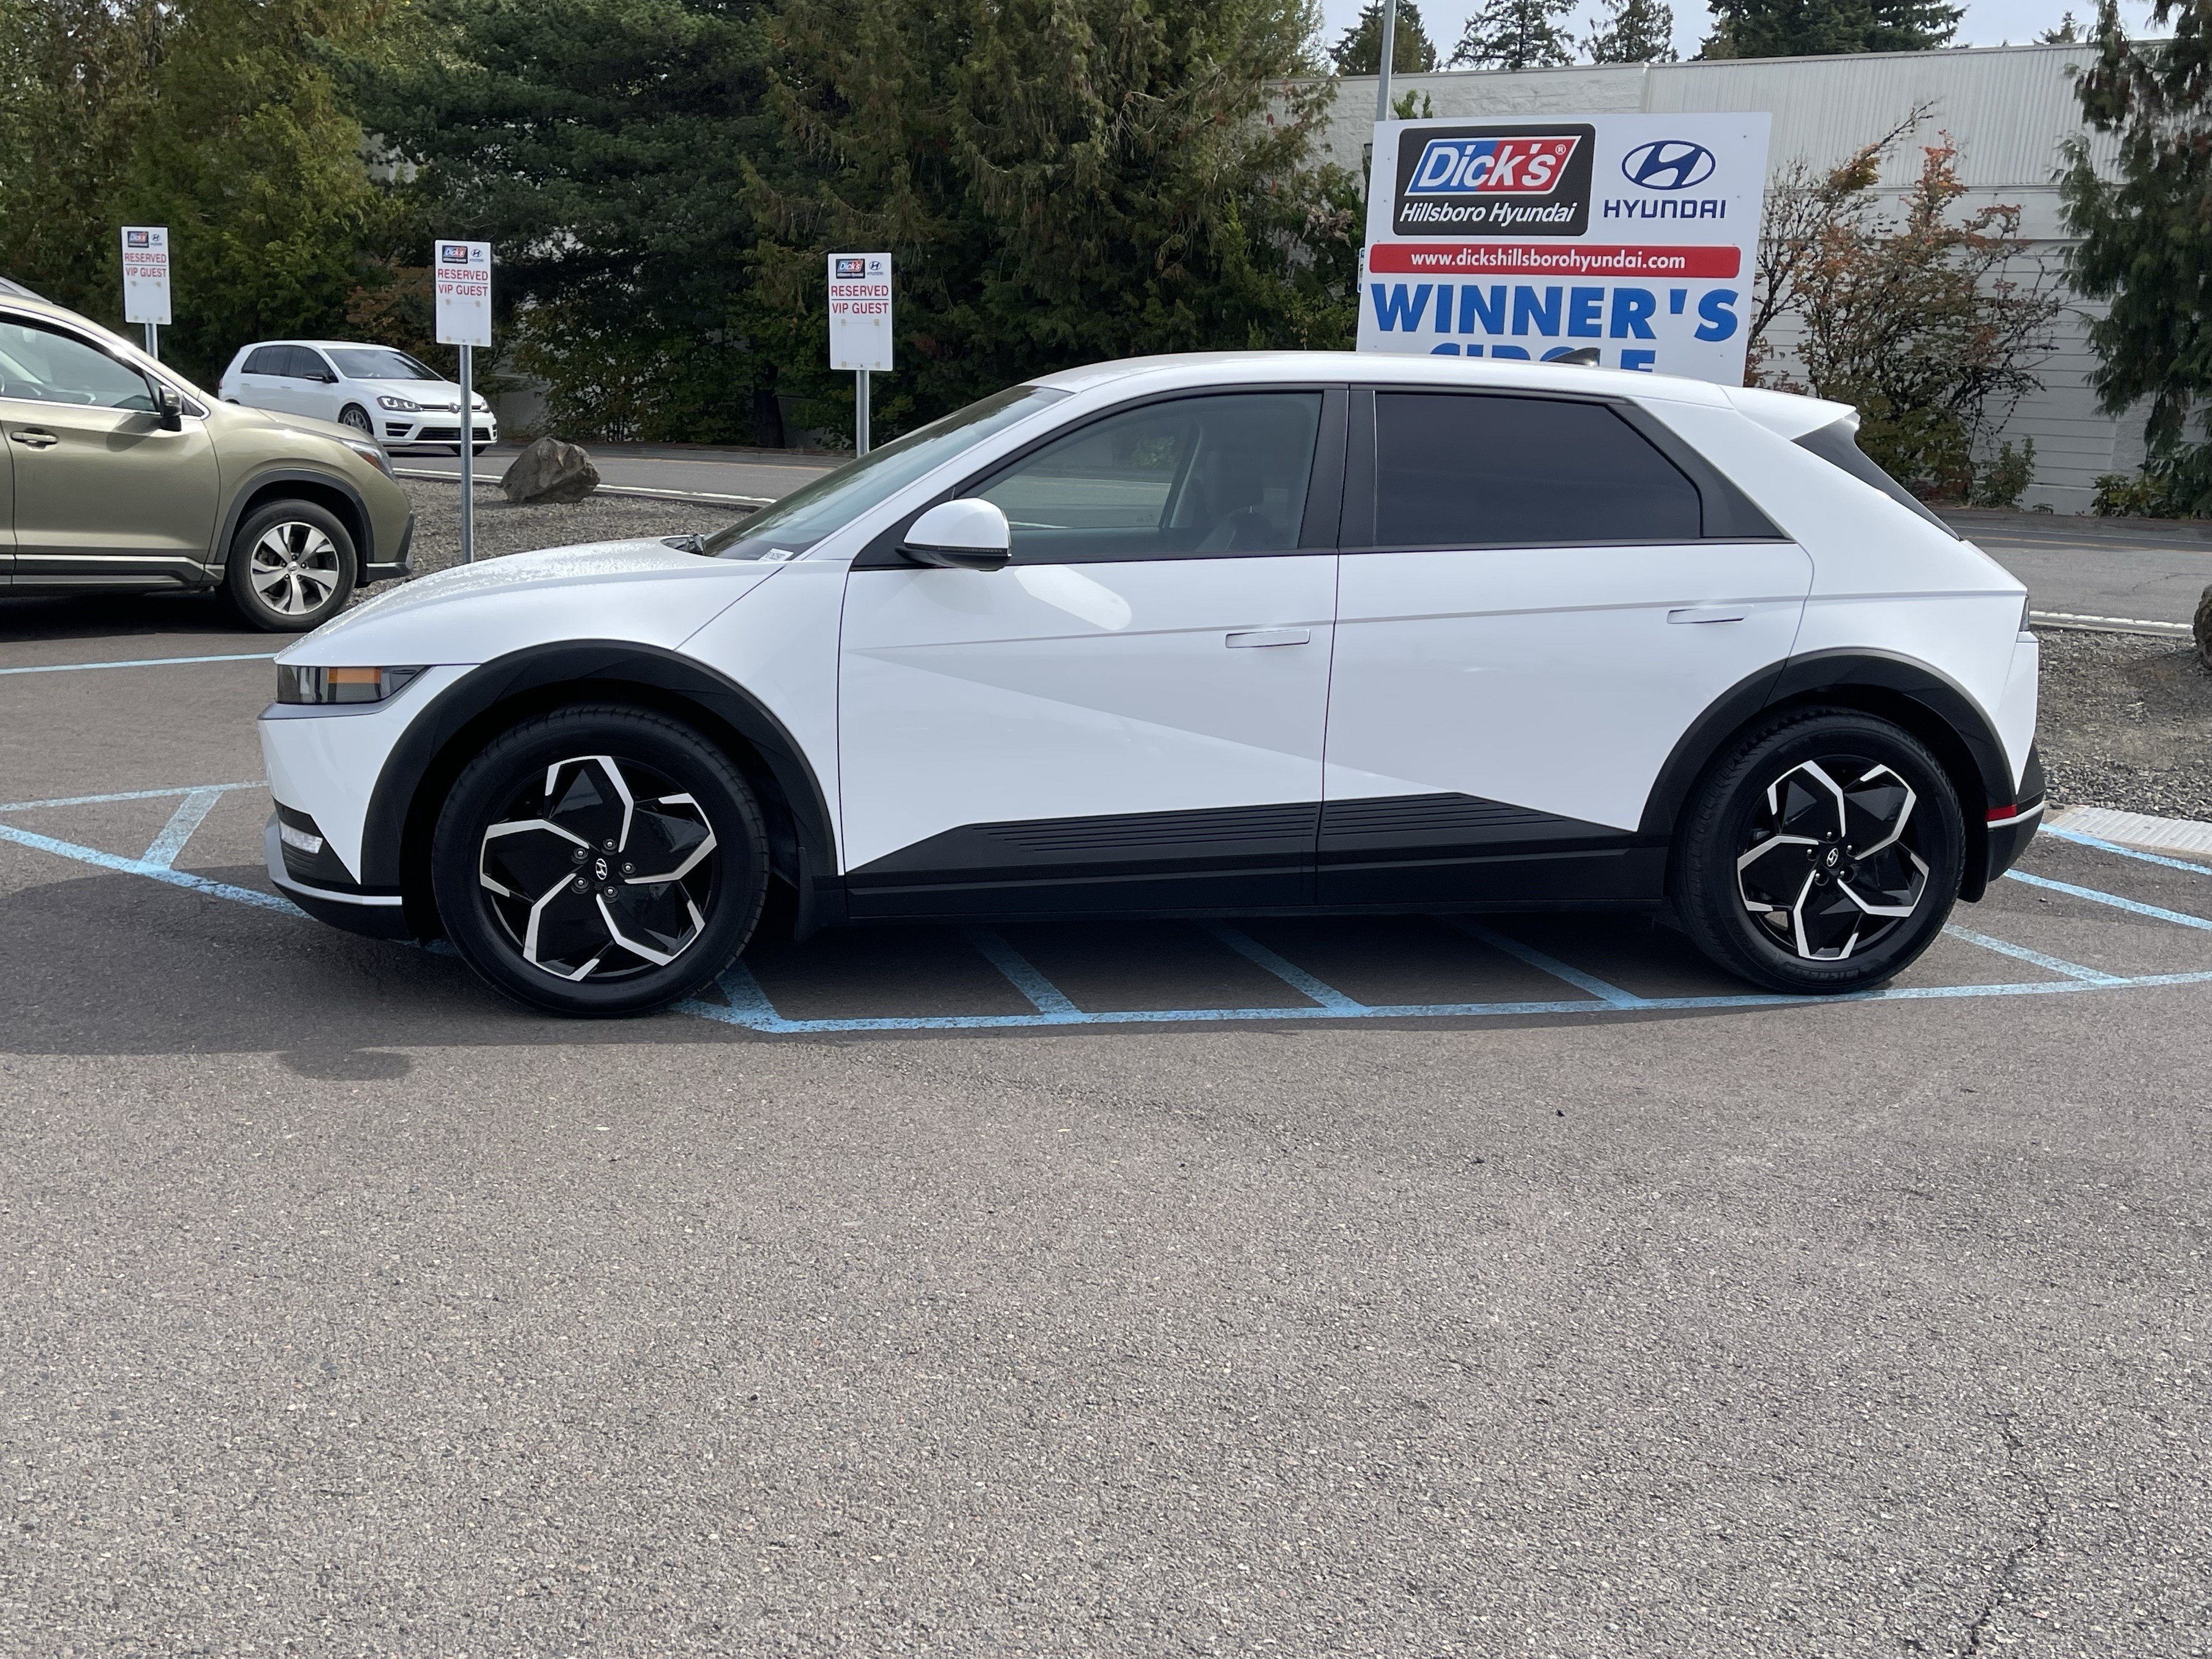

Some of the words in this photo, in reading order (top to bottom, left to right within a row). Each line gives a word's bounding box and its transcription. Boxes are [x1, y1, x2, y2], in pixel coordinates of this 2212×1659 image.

[1418, 143, 1556, 188] Dick's
[1400, 202, 1487, 222] Hillsboro
[1488, 202, 1578, 227] Hyundai
[1603, 199, 1726, 219] HYUNDAI
[125, 252, 167, 263] RESERVED
[1410, 248, 1686, 271] www.dickshillsborohyundai.com
[125, 267, 138, 276] VIP
[140, 267, 167, 278] GUEST
[438, 268, 488, 281] RESERVED
[438, 284, 453, 294] VIP
[456, 285, 488, 296] GUEST
[831, 285, 889, 297] RESERVED
[832, 302, 849, 314] VIP
[852, 302, 889, 314] GUEST
[1371, 284, 1739, 342] WINNER'S
